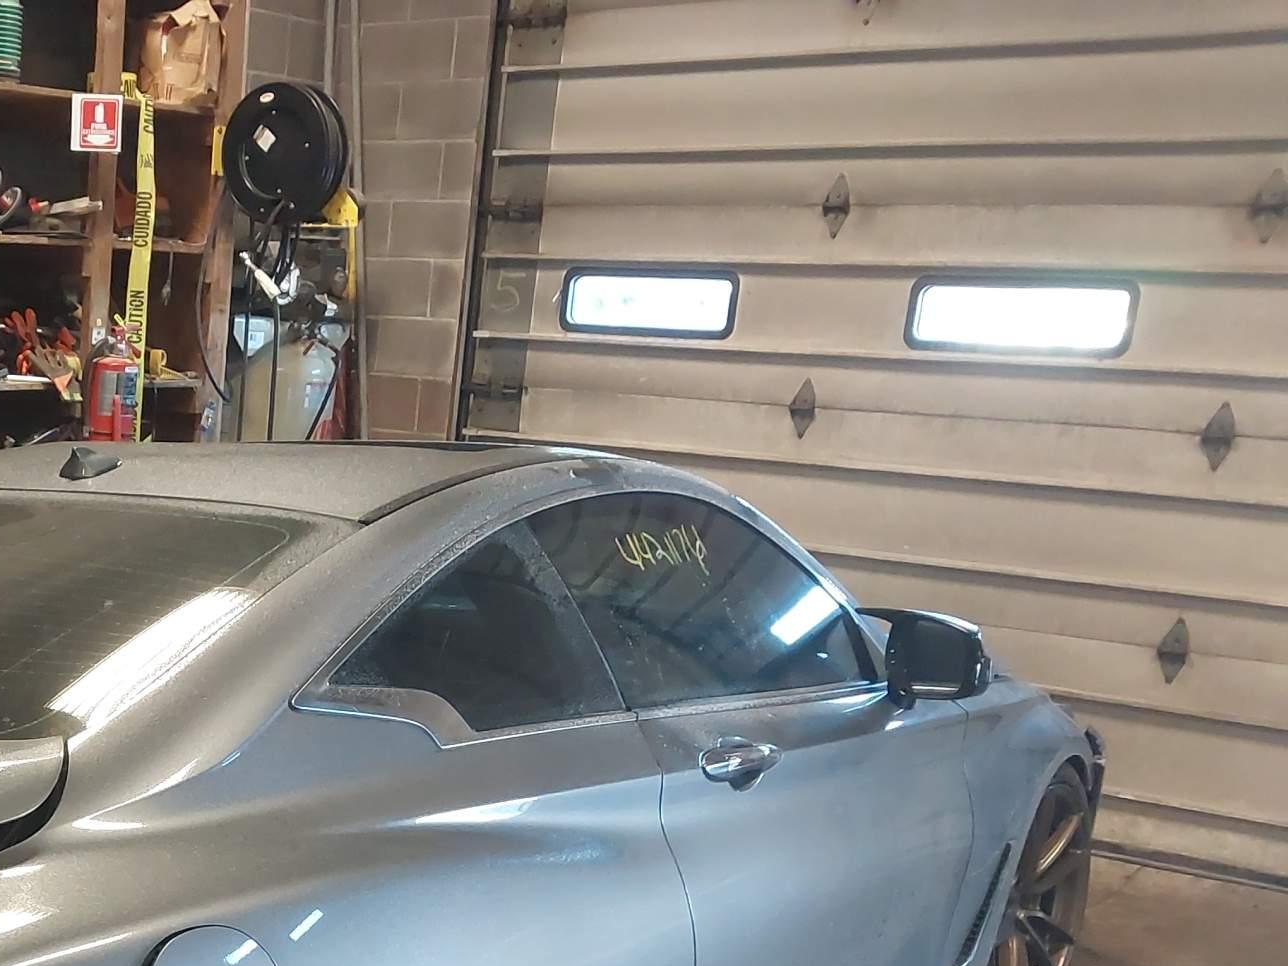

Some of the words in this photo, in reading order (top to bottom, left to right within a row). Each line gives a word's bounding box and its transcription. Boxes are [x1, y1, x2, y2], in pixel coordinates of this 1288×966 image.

[133, 191, 153, 248] CUIDADO
[126, 289, 145, 345] CAUTION
[490, 269, 527, 313] 5
